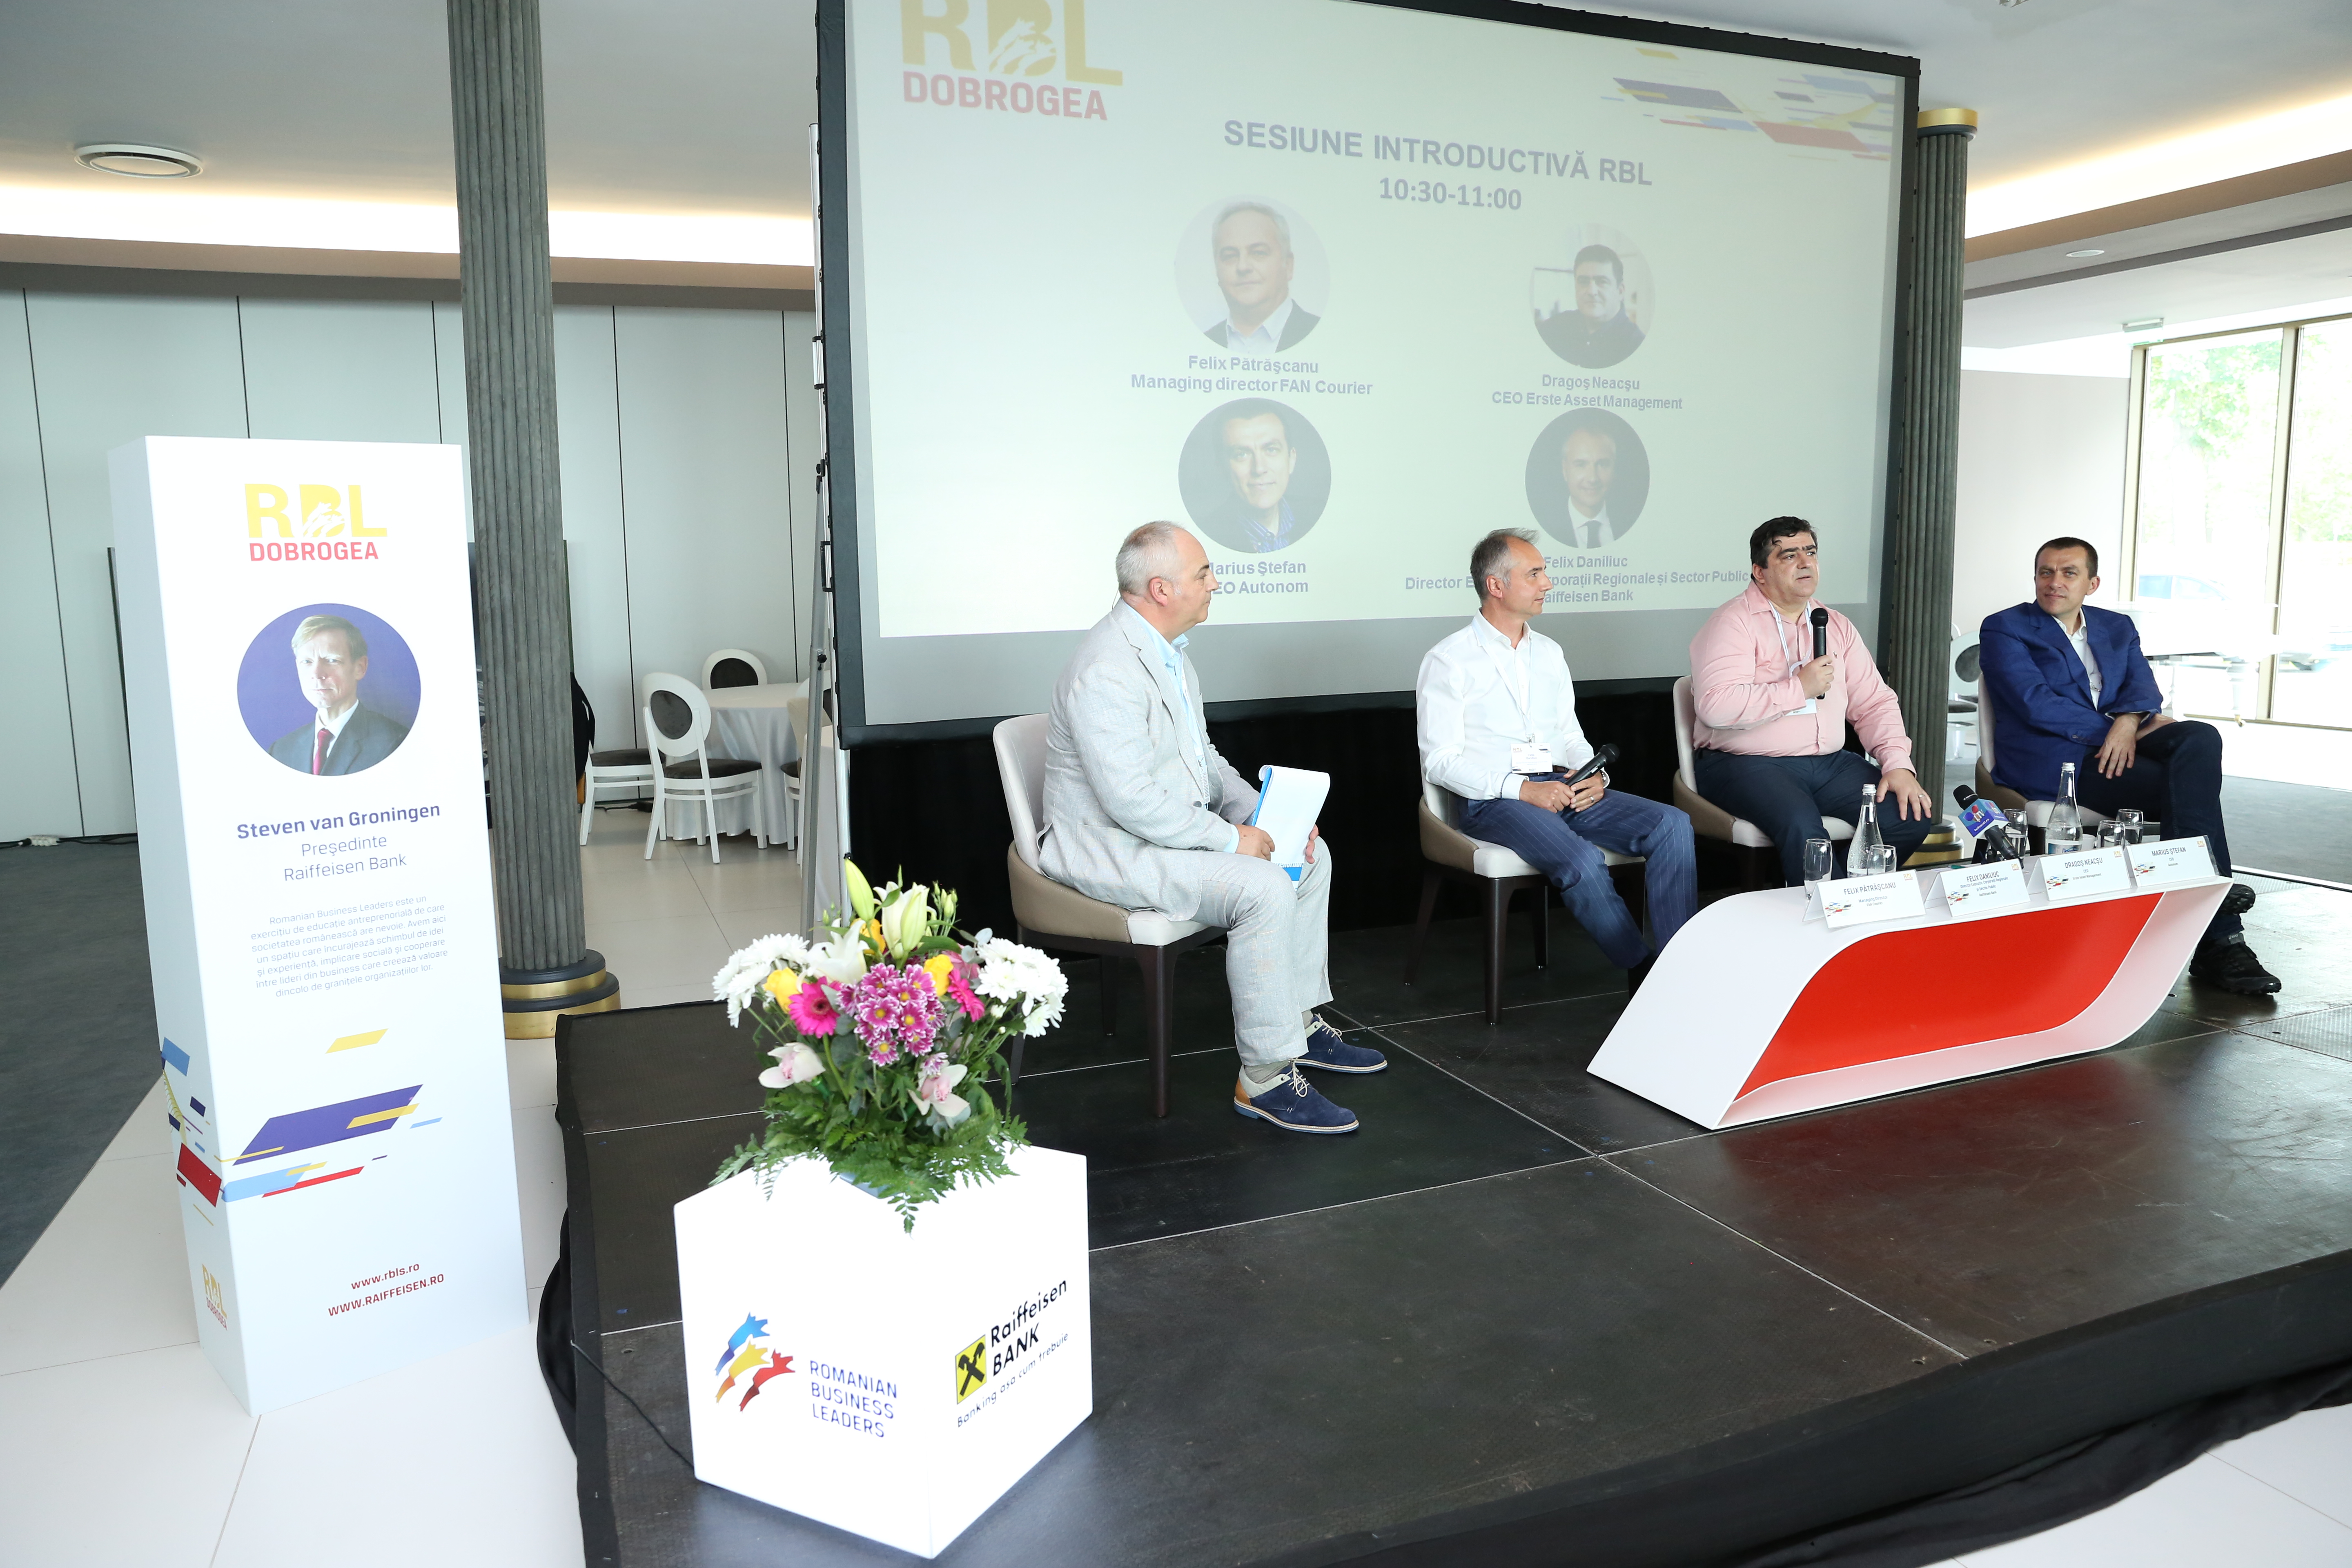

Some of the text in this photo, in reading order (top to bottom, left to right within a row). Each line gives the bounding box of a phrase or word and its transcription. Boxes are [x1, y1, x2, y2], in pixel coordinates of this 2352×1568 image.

[901, 0, 1123, 86] RBL
[903, 71, 1107, 120] DOBROGEA
[1224, 119, 1652, 186] SESIUNE INTRODUCTIVĂ RBL
[1379, 177, 1522, 210] 10:30-11:00
[1188, 355, 1226, 370] Felix
[1131, 374, 1373, 394] Managing director FAN Courier
[1492, 391, 1682, 411] CEO Erste Asset Management
[245, 483, 388, 538] RBL
[249, 542, 379, 561] DOBROGEA
[1577, 555, 1628, 568] Daniliuc
[1209, 562, 1255, 575] arius
[1593, 572, 1655, 588] Regionale
[1670, 572, 1710, 583] Sector
[1713, 570, 1748, 582] Public
[1213, 581, 1309, 595] EO Autonom
[1405, 577, 1462, 589] Director
[1544, 589, 1634, 603] aiffeisen Bank
[237, 805, 440, 839] Steven van Groningen
[284, 854, 407, 881] Raiffeisen Bank
[1979, 871, 2000, 880] DANILIUC
[270, 913, 314, 924] Romanian
[317, 906, 357, 918] Business
[360, 901, 393, 911] Leaders
[348, 909, 412, 925] antreprenorială
[252, 939, 300, 952] societatea
[303, 929, 357, 944] românească
[376, 922, 405, 933] nevoie.
[408, 919, 430, 927] Avem
[432, 915, 446, 923] aici
[302, 948, 322, 956] care
[324, 938, 374, 953] încurajează
[376, 931, 414, 944] schimbul
[429, 927, 443, 935] idei
[321, 953, 360, 965] implicare
[363, 947, 392, 958] socială
[404, 939, 445, 950] cooperare
[256, 979, 277, 988] între
[280, 973, 301, 984] lideri
[320, 964, 360, 977] business
[362, 962, 381, 970] care
[383, 955, 416, 966] creează
[419, 950, 448, 960] valoare
[276, 985, 308, 997] dincolo
[351, 1263, 420, 1290] www.rbls.ro
[328, 1274, 445, 1316] WWW.RAIFFEISEN.RO
[991, 1280, 1067, 1348] Raiffeisen
[993, 1322, 1039, 1377] BANK
[810, 1360, 897, 1399] ROMANIAN
[958, 1391, 996, 1428] Banking
[1019, 1360, 1036, 1378] cum
[1039, 1333, 1068, 1362] trebuie
[811, 1382, 894, 1419] BUSINESS
[813, 1403, 885, 1438] LEADERS
